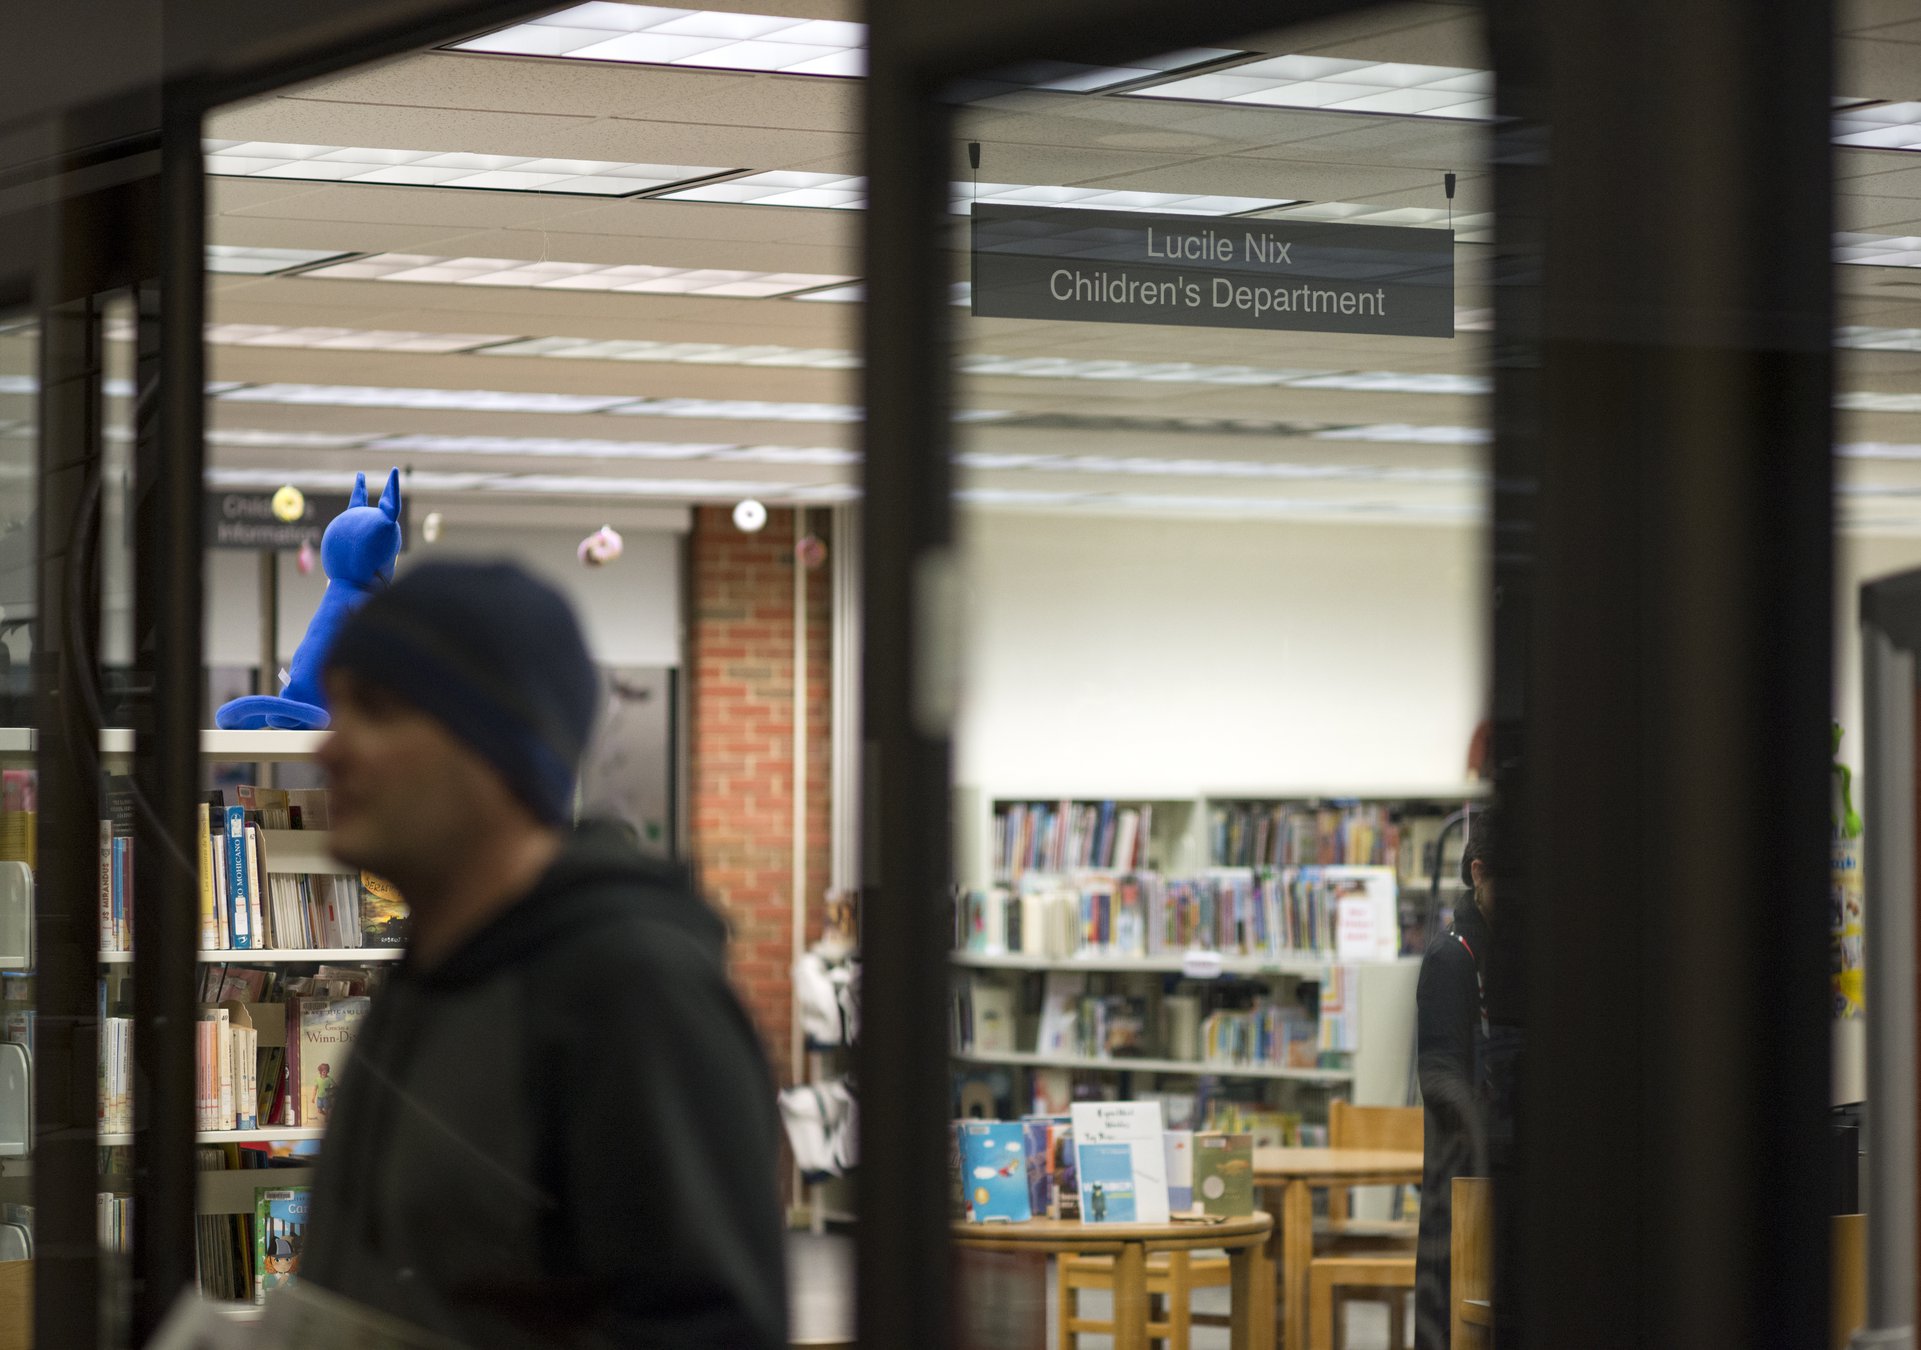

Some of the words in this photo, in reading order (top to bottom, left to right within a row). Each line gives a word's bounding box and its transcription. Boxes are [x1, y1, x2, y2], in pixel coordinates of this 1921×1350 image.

[1146, 226, 1234, 262] Lucile
[1244, 232, 1292, 264] Nix
[1050, 269, 1202, 307] Children's
[1212, 278, 1386, 317] Department
[235, 839, 243, 886] MOHICANO
